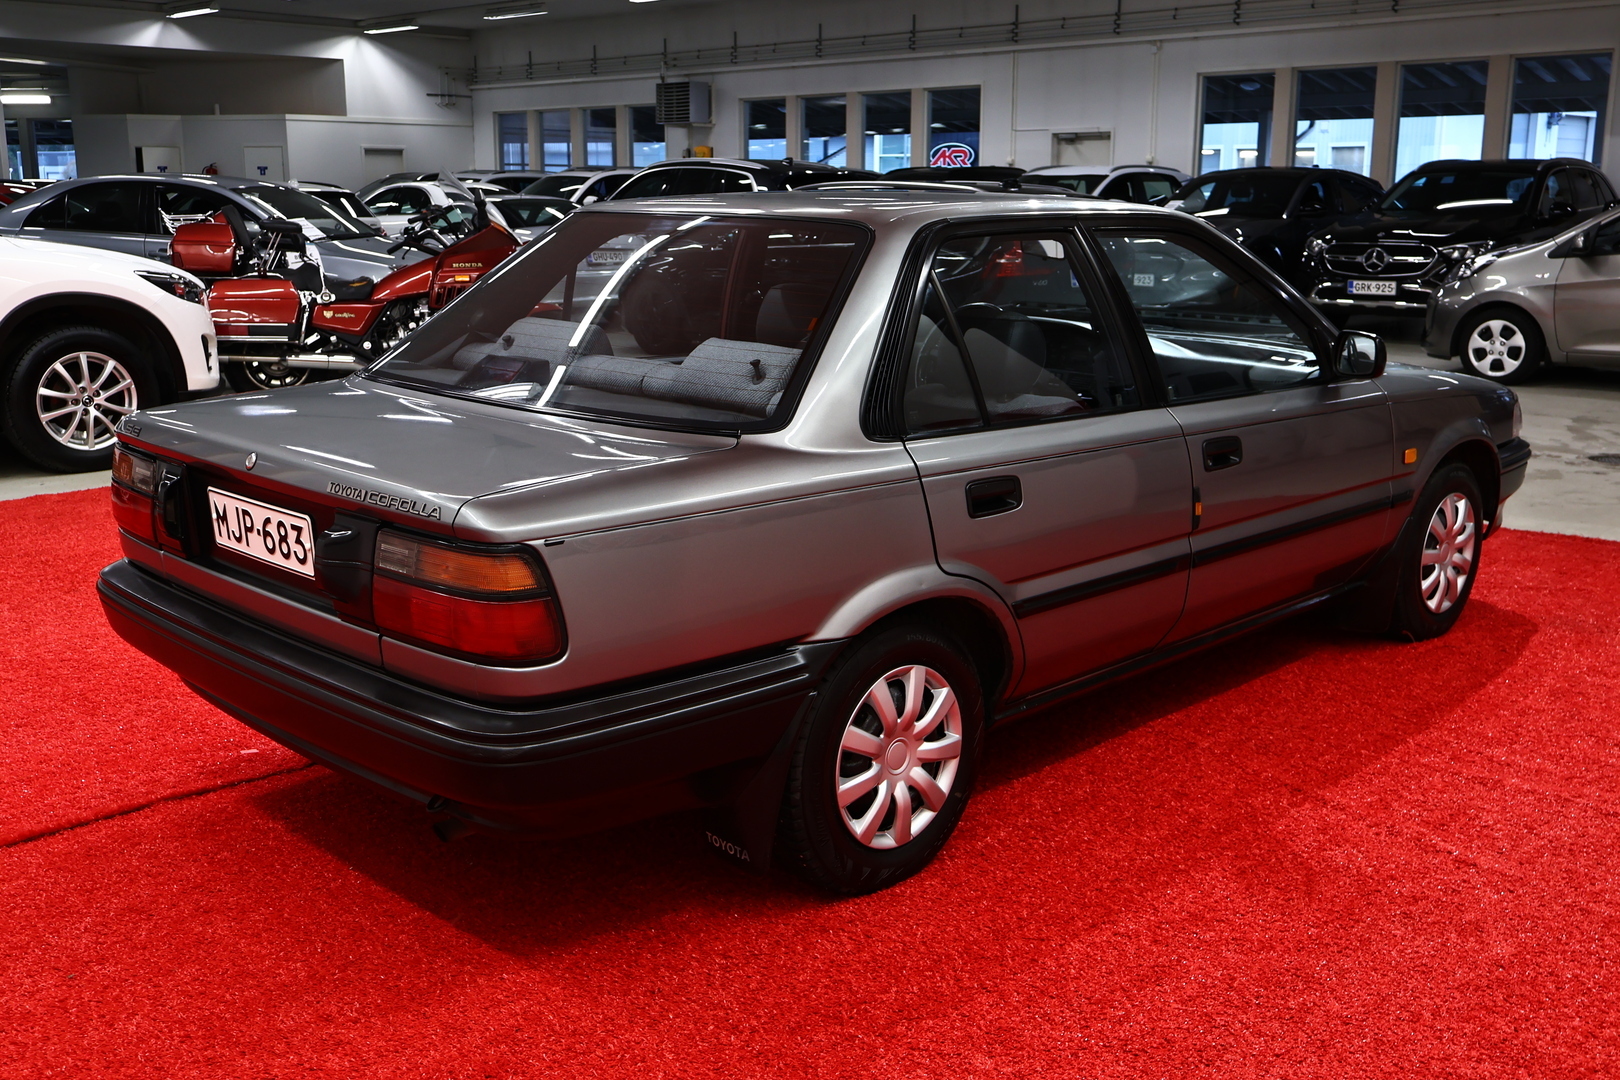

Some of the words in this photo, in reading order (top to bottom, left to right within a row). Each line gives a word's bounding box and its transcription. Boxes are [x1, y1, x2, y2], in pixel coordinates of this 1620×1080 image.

[592, 252, 623, 262] GHU-490
[1354, 282, 1395, 293] GRK-925
[329, 481, 362, 500] TOYOTA
[367, 490, 441, 520] COROLLA
[212, 498, 308, 565] MJP-683
[705, 831, 750, 862] TOYOTA
